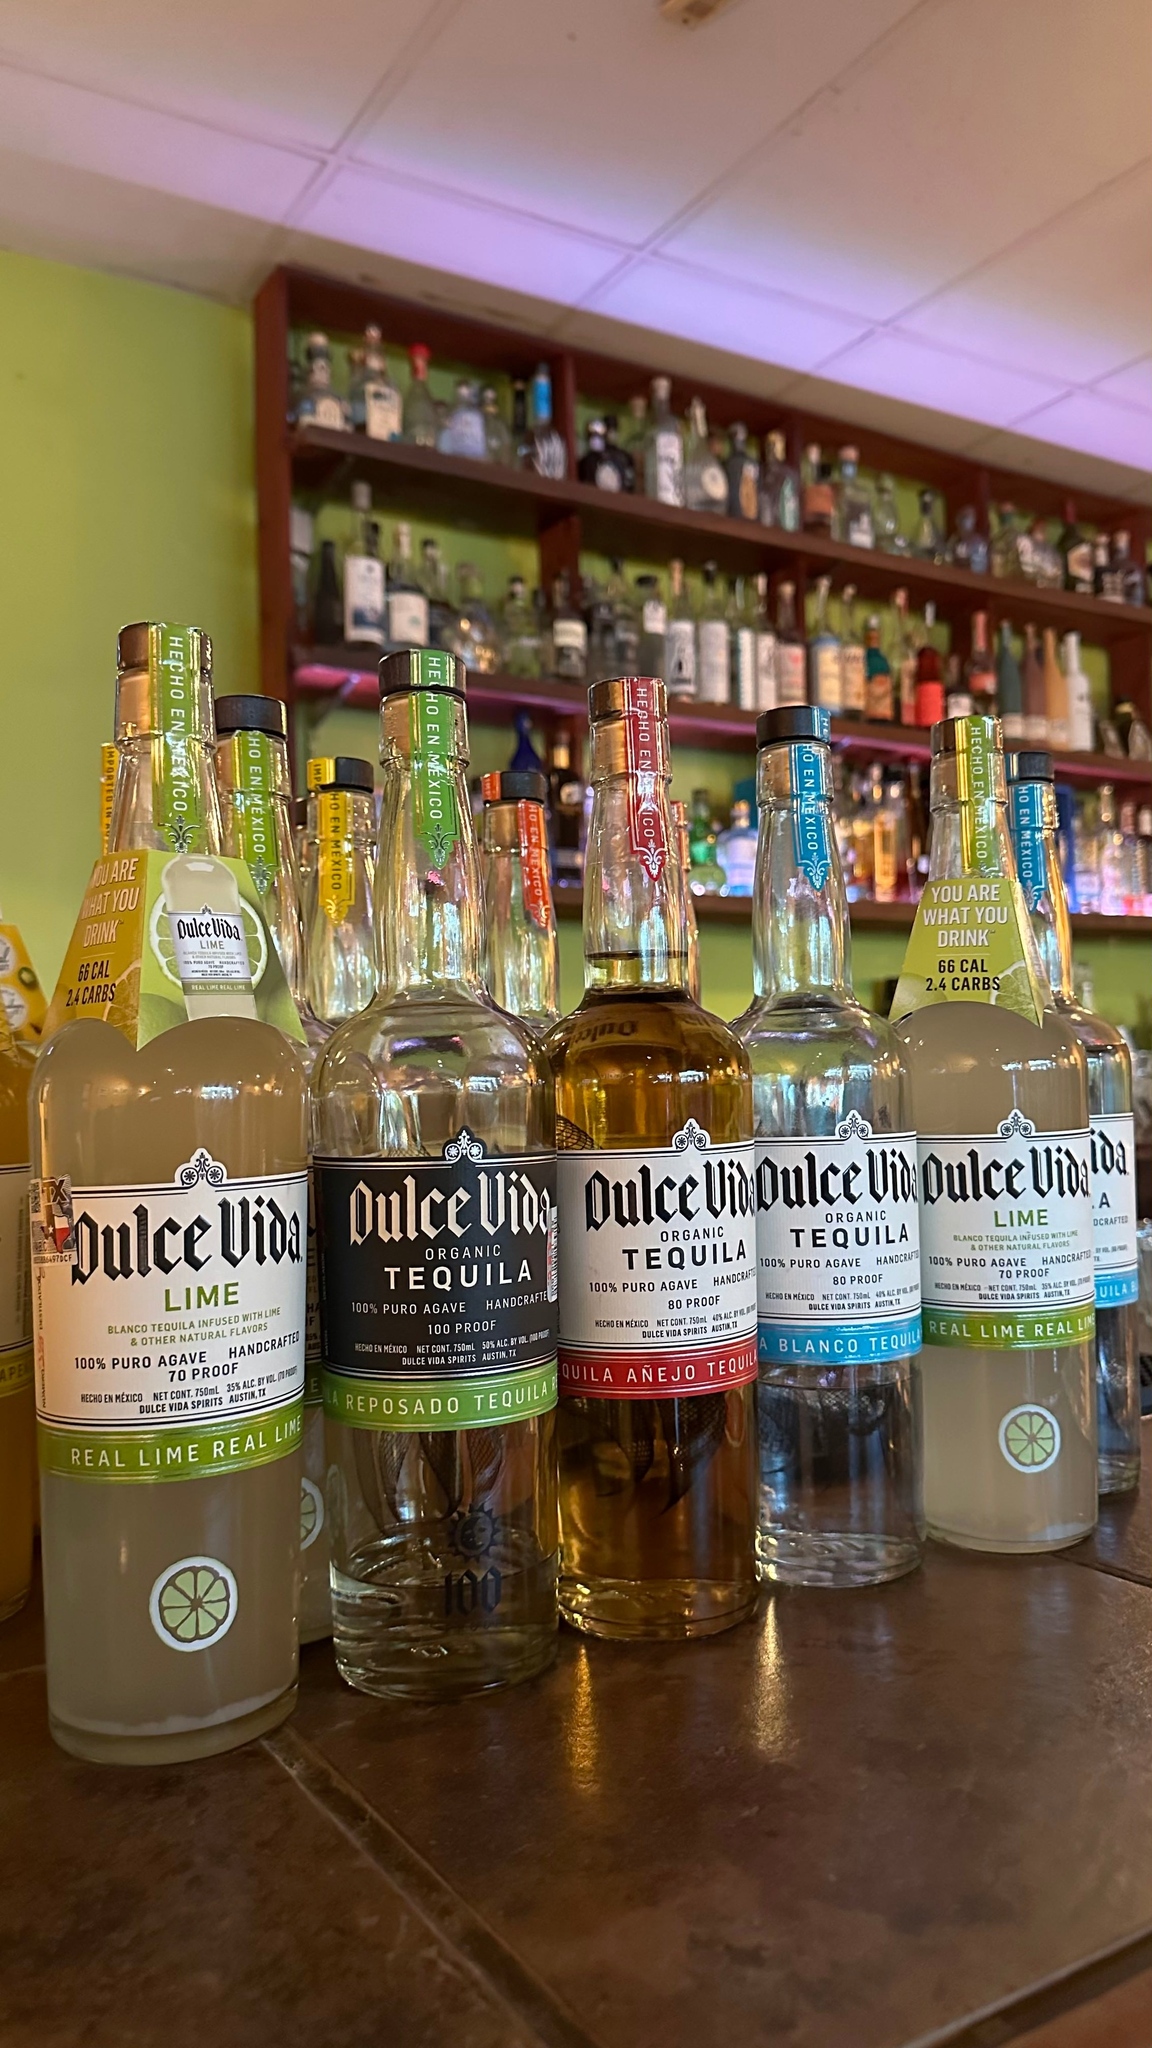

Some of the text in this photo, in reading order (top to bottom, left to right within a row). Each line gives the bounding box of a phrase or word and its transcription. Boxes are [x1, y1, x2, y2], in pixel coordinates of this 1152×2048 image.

[169, 636, 184, 700] HECHO
[170, 709, 185, 732] EN
[636, 688, 650, 742] HECHO
[427, 724, 440, 745] EN
[639, 750, 651, 774] EN
[970, 727, 984, 776] HECHO
[803, 769, 815, 788] EN
[973, 782, 985, 800] EN
[249, 766, 266, 854] EN MÉXICO
[1018, 808, 1031, 825] EN
[110, 858, 139, 883] ARE
[112, 886, 140, 912] YOU
[931, 884, 1001, 904] YOU ARE
[923, 906, 1008, 926] WHAT YOU
[177, 917, 241, 941] Dulce Vida
[199, 940, 225, 950] LIME
[78, 960, 110, 982] 66 CAL
[938, 959, 989, 974] 66 CAL
[66, 983, 117, 1007] 2.4 CARBS
[925, 976, 1001, 992] 2.4 CARBS
[1090, 1127, 1128, 1176] ida
[755, 1148, 918, 1212] Dulce Vida
[921, 1145, 1090, 1206] Dulce Vida
[585, 1158, 756, 1232] Dulce Vida
[349, 1169, 550, 1246] Dulce Vida
[825, 1210, 887, 1224] ORGANIC
[993, 1208, 1049, 1228] LIME
[1093, 1215, 1129, 1227] DCRAFTED
[71, 1203, 213, 1286] Dulce
[217, 1194, 303, 1269] Vida
[660, 1226, 724, 1243] ORGANIC
[789, 1222, 909, 1250] TEQUILA
[953, 1234, 984, 1242] BLANCO
[985, 1233, 1018, 1243] TEQUILA
[1019, 1232, 1050, 1241] INFUSED
[978, 1243, 1005, 1251] OTHER
[1006, 1242, 1041, 1251] NATURAL
[1042, 1240, 1070, 1249] FLAVORS
[424, 1244, 501, 1261] ORGANIC
[621, 1239, 747, 1271] TEQUILA
[760, 1258, 786, 1268] 100%
[790, 1259, 820, 1268] PURO
[825, 1258, 861, 1268] AGAVE
[928, 1256, 953, 1266] 100%
[956, 1257, 986, 1267] PURO
[990, 1257, 1027, 1267] AGAVE
[1041, 1249, 1091, 1266] HANDCRAFTED
[384, 1259, 532, 1292] TEQUILA
[833, 1273, 884, 1286] 80 PROOF
[999, 1268, 1050, 1279] 70 PROOF
[164, 1281, 240, 1312] LIME
[589, 1282, 618, 1293] 100%
[622, 1281, 655, 1293] PURO
[660, 1279, 698, 1292] AGAVE
[351, 1291, 547, 1315] 100% PURO AGAVE HANDCRAFTE
[668, 1295, 721, 1310] 80 PROOF
[107, 1306, 281, 1335] BLANCO TEQUILA INFUSED WITH LIME
[428, 1319, 497, 1335] 100 PROOF
[929, 1320, 972, 1338] REAL
[980, 1324, 1025, 1338] LIME
[1034, 1320, 1073, 1338] REAL
[130, 1322, 268, 1347] & OTHER NATURAL FLAVORS
[374, 1344, 383, 1353] EN
[383, 1343, 408, 1354] MÉXICO
[416, 1344, 430, 1354] NET
[431, 1344, 452, 1354] CONT.
[453, 1342, 476, 1352] 750mL
[481, 1340, 495, 1350] 50%
[510, 1336, 518, 1346] BY
[778, 1337, 858, 1354] BLANCO
[869, 1329, 921, 1350] TEQUILA
[74, 1357, 106, 1370] 100%
[112, 1356, 151, 1370] PURO
[158, 1351, 207, 1368] AGAVE
[229, 1330, 300, 1360] HANDCRAFTED
[402, 1357, 426, 1366] DULCE
[427, 1356, 446, 1366] VIDA
[447, 1354, 477, 1364] SPIRITS
[508, 1348, 517, 1358] TX
[168, 1362, 239, 1383] 70 PROOF
[562, 1363, 614, 1383] QUILA
[626, 1364, 696, 1383] AÑEJO
[707, 1349, 757, 1377] TEQUILA
[81, 1393, 103, 1403] HECHO
[104, 1394, 114, 1403] EN
[115, 1391, 143, 1403] MÉXICO
[153, 1391, 168, 1402] NET
[170, 1389, 194, 1400] CONT.
[195, 1386, 220, 1397] 750mL
[226, 1382, 241, 1393] 35%
[242, 1379, 257, 1389] ALC.
[257, 1376, 265, 1387] BY
[139, 1387, 267, 1414] DULCE VIDA SPIRITS AUSTIN, TX
[346, 1394, 459, 1415] REPOSADO
[473, 1380, 548, 1411] TEQUILA
[71, 1413, 301, 1468] REAL LIME REAL LIME
